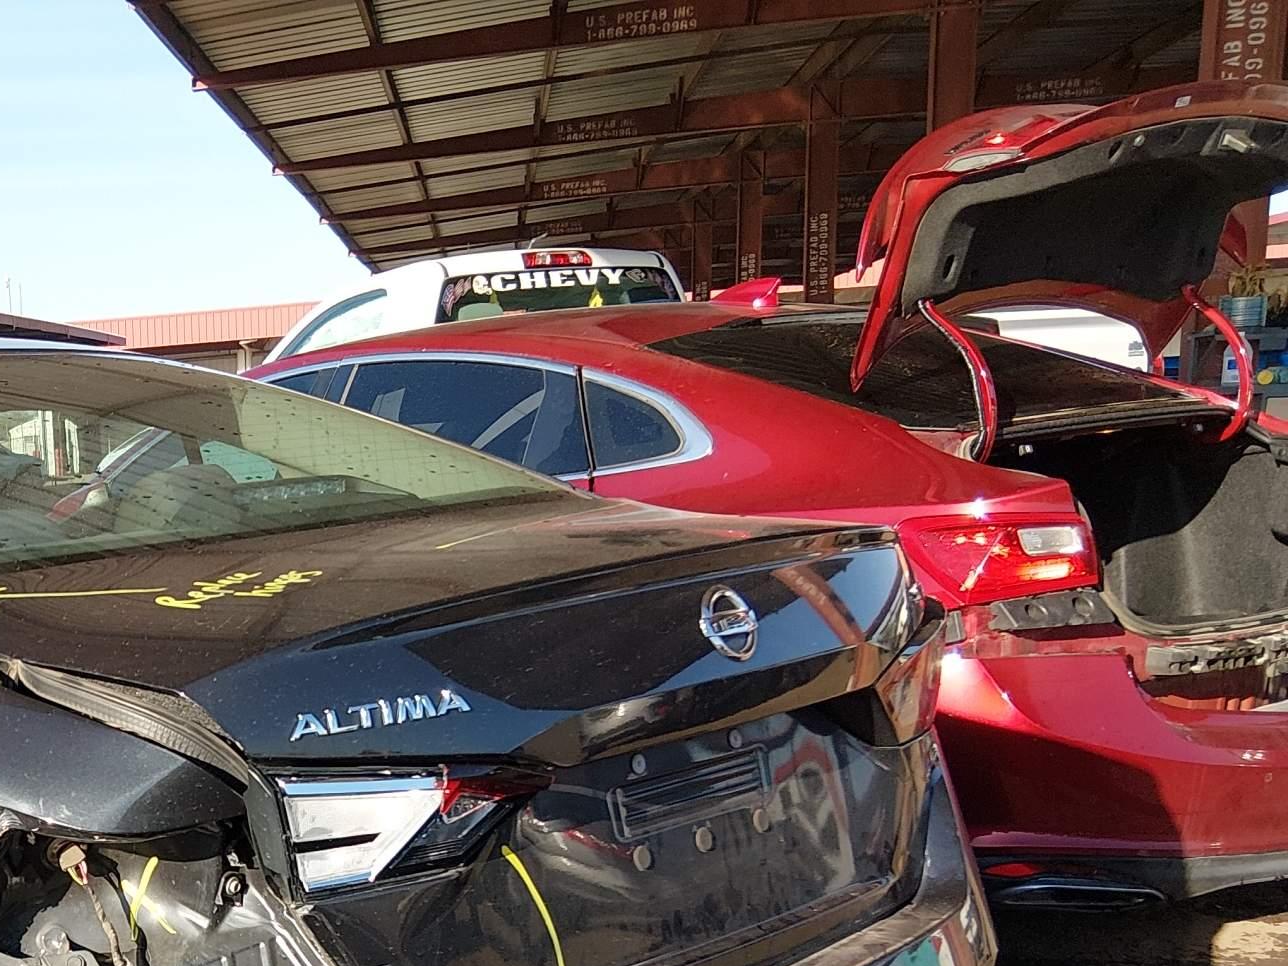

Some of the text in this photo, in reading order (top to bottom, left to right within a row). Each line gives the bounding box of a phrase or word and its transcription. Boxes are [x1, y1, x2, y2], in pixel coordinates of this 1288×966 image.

[617, 8, 667, 24] PREFAB
[490, 268, 625, 292] CHEVY
[289, 689, 472, 742] ALTIMA
